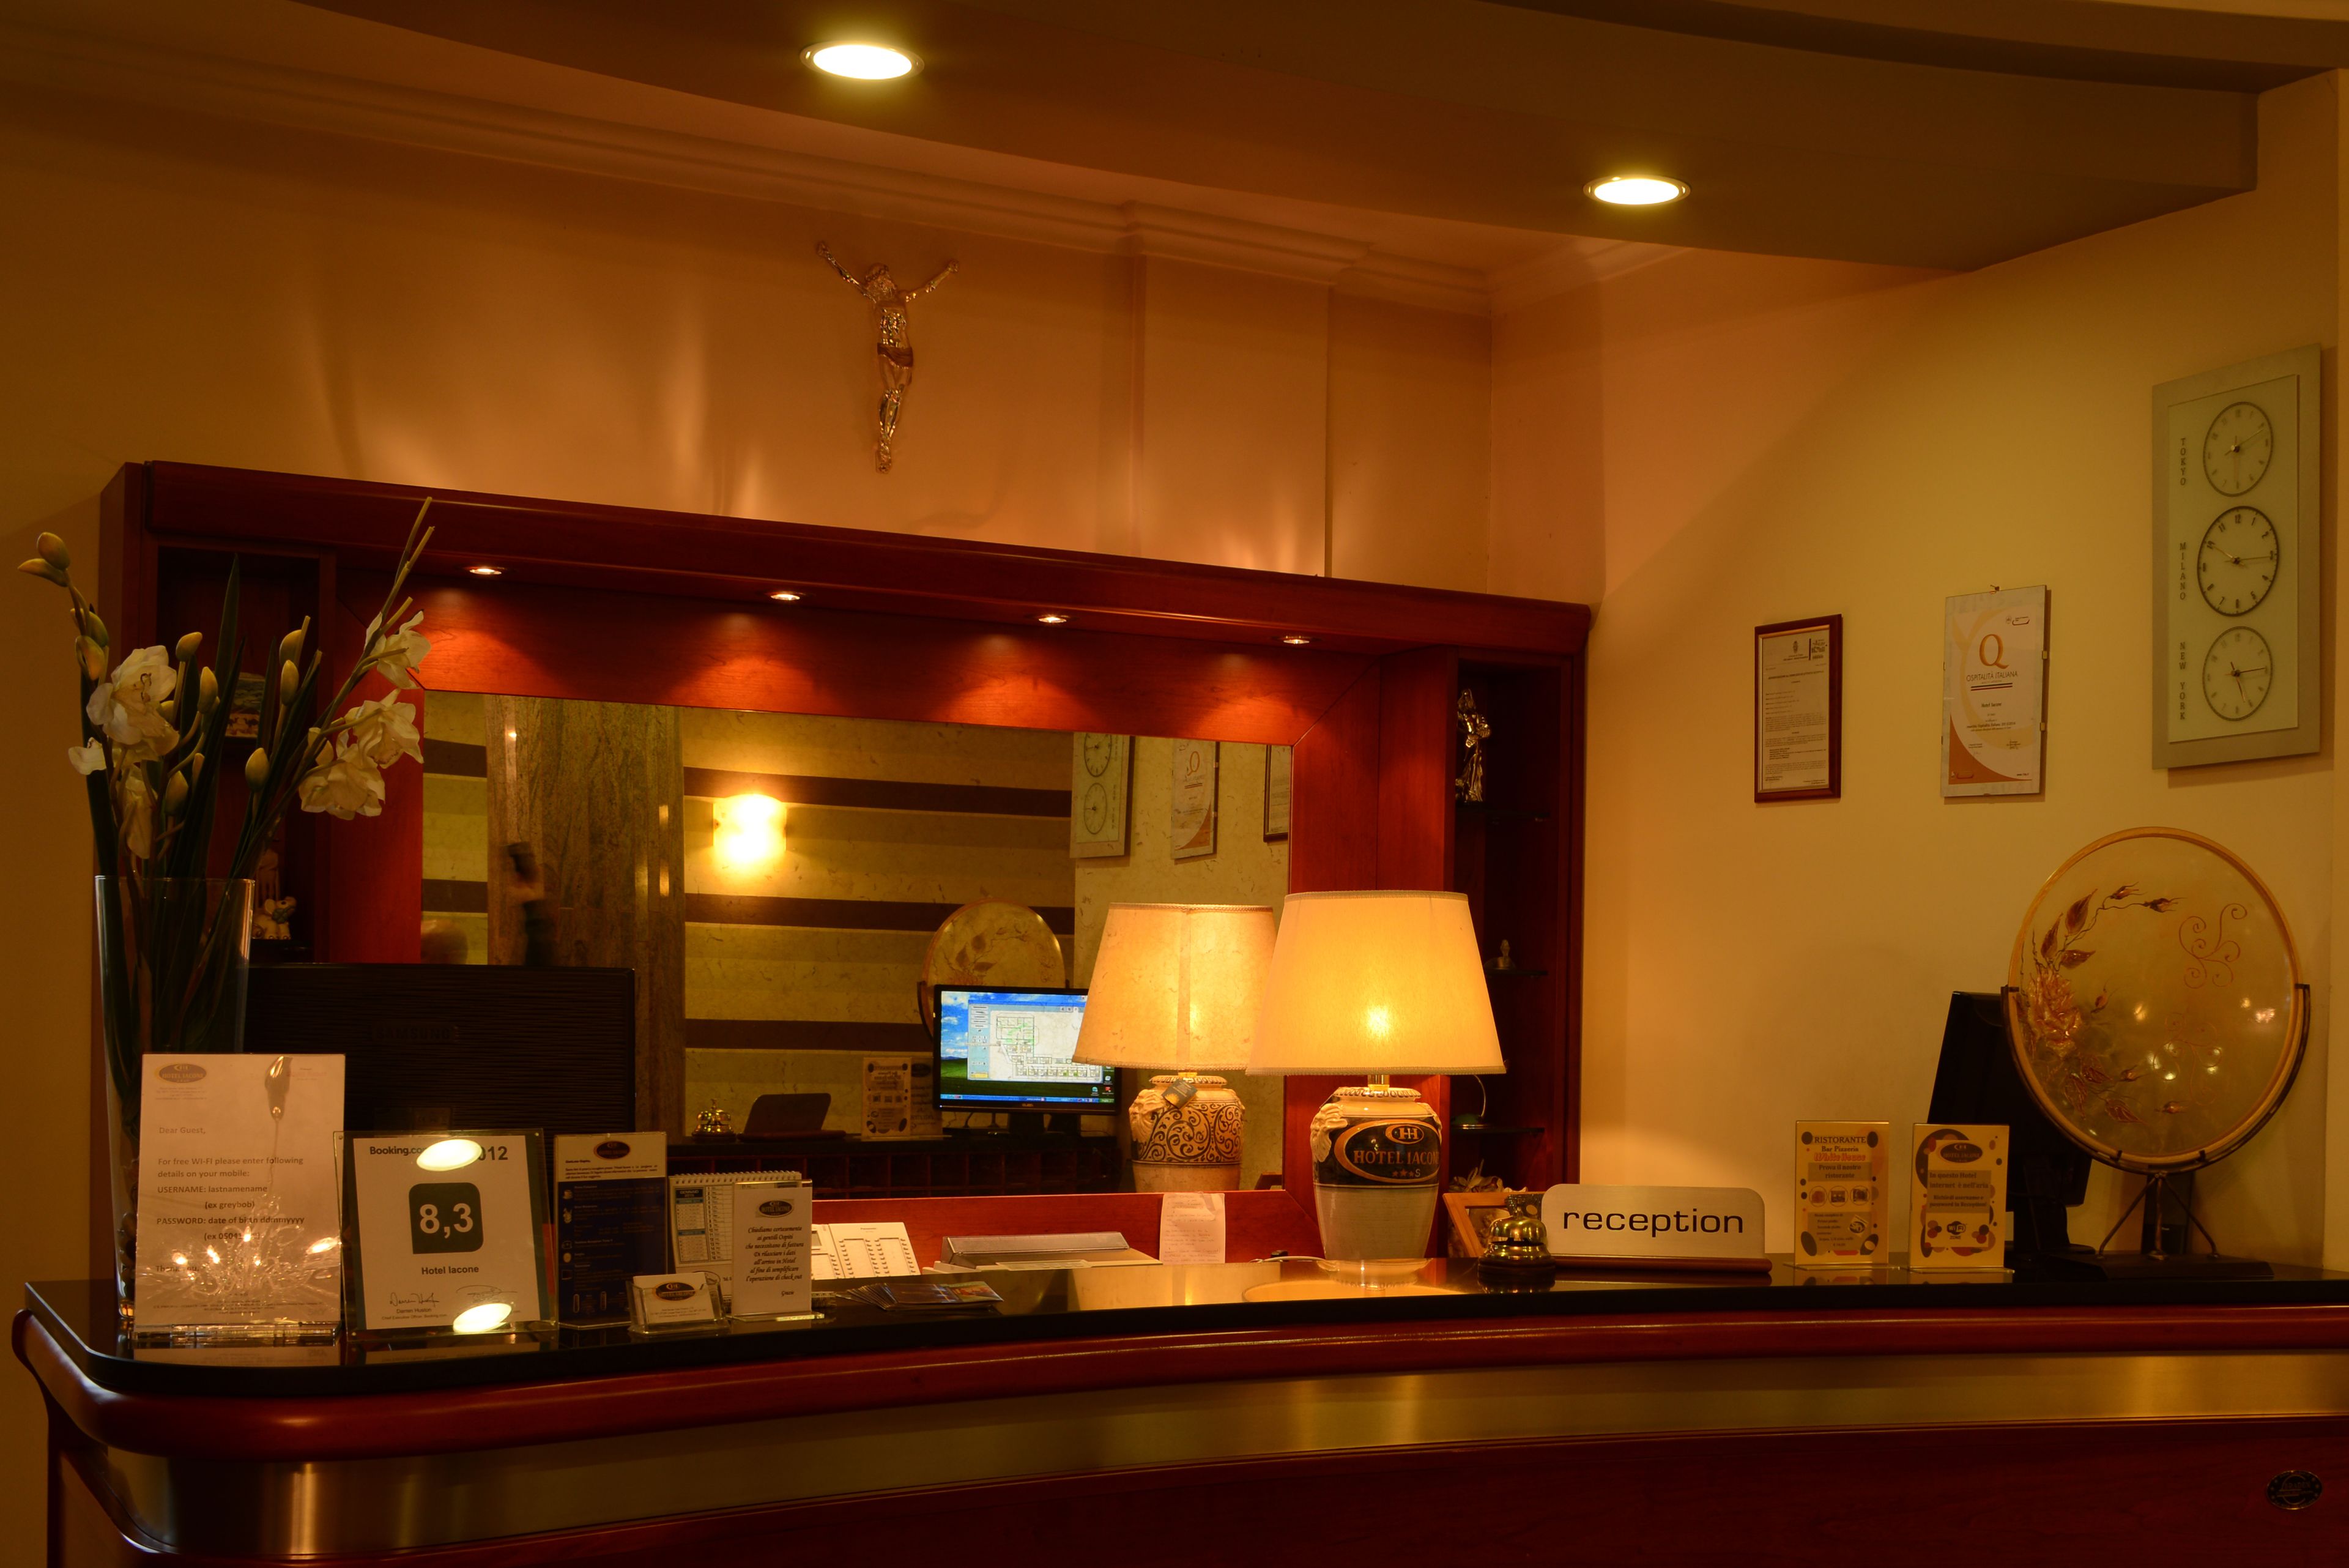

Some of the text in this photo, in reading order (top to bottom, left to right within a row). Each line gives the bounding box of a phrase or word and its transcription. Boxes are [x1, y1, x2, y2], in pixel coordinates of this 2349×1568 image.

[2235, 513, 2241, 524] 12
[2251, 517, 2256, 526] 1
[2218, 523, 2226, 532] 11
[2219, 596, 2225, 605] 7
[2251, 591, 2257, 600] 5
[1979, 634, 2010, 669] Q
[1995, 671, 2018, 679] ITALIANA
[215, 1157, 239, 1167] please
[266, 1156, 303, 1165] following
[1353, 1150, 1403, 1165] HOTEL
[1416, 1169, 1420, 1178] S
[420, 1203, 473, 1239] 8,3
[1564, 1209, 1743, 1237] reception
